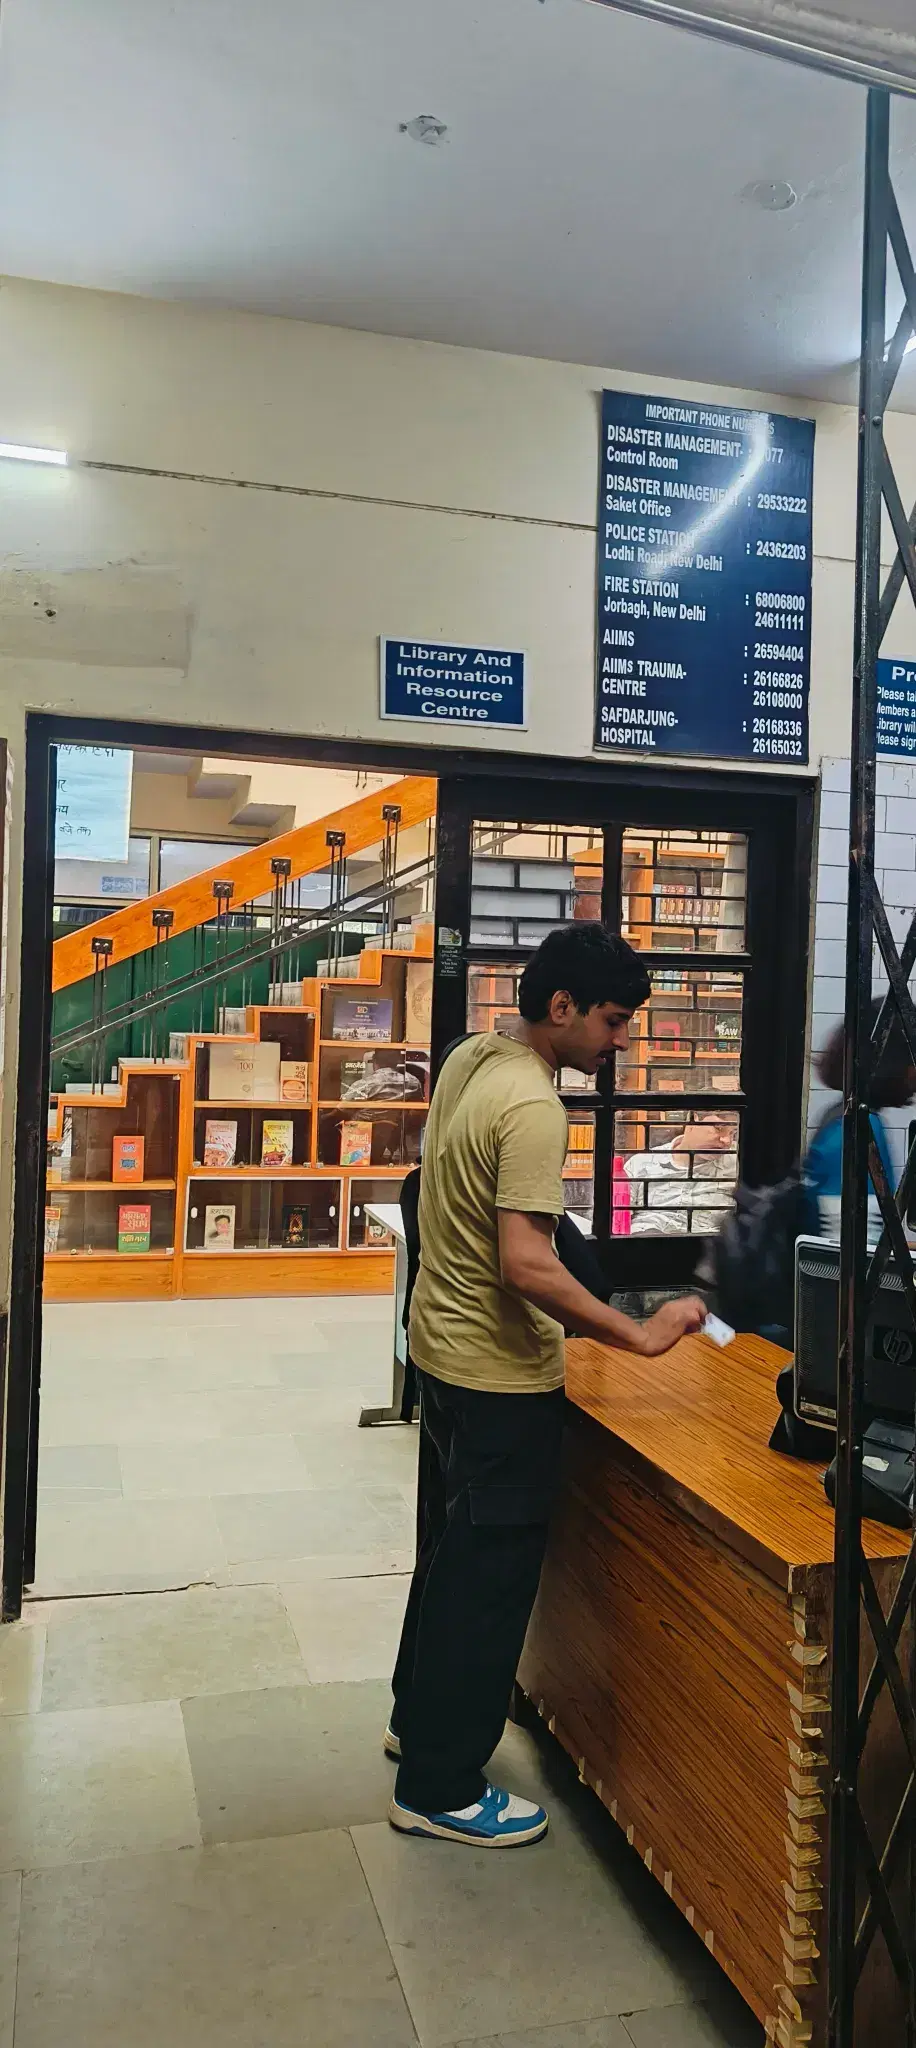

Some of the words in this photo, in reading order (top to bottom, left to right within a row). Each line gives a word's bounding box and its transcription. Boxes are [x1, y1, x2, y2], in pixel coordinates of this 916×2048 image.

[646, 404, 698, 424] IMPORTANT
[700, 412, 730, 429] PHONE
[607, 425, 661, 448] DISASTER
[761, 446, 784, 464] 077
[606, 446, 645, 465] Control
[649, 452, 678, 471] Room
[606, 474, 660, 497] DISASTER
[757, 493, 807, 514] 29533222
[606, 495, 637, 513] Saket
[639, 499, 671, 517] Office
[606, 523, 646, 542] POLICE
[648, 528, 696, 548] STATION
[605, 544, 635, 561] Lodhi
[670, 552, 694, 568] New
[696, 554, 723, 571] Delhi
[756, 541, 807, 561] 24362203
[605, 576, 630, 593] FIRE
[632, 579, 679, 598] STATION
[604, 597, 650, 619] Jorbagh,
[653, 601, 677, 618] New
[679, 604, 706, 621] Delhi
[755, 592, 805, 612] 68006800
[755, 612, 804, 630] 24611111
[603, 629, 635, 646] AIIMS
[400, 646, 467, 666] Library
[474, 653, 511, 667] And
[754, 643, 804, 662] 26594404
[397, 663, 513, 685] Information
[638, 661, 687, 679] TRAUMA-
[603, 678, 646, 696] CENTRE
[753, 671, 803, 690] 26166826
[407, 683, 503, 702] Resource
[753, 691, 803, 709] 26108000
[421, 702, 488, 719] Centre
[602, 707, 679, 727] SAFDARJUNG-
[752, 718, 802, 736] 26168336
[877, 718, 902, 734] ibrary
[602, 727, 656, 746] HOSPITAL
[876, 734, 899, 746] lease
[752, 738, 802, 756] 26165032
[240, 1062, 254, 1070] 100
[885, 1328, 911, 1364] hp
